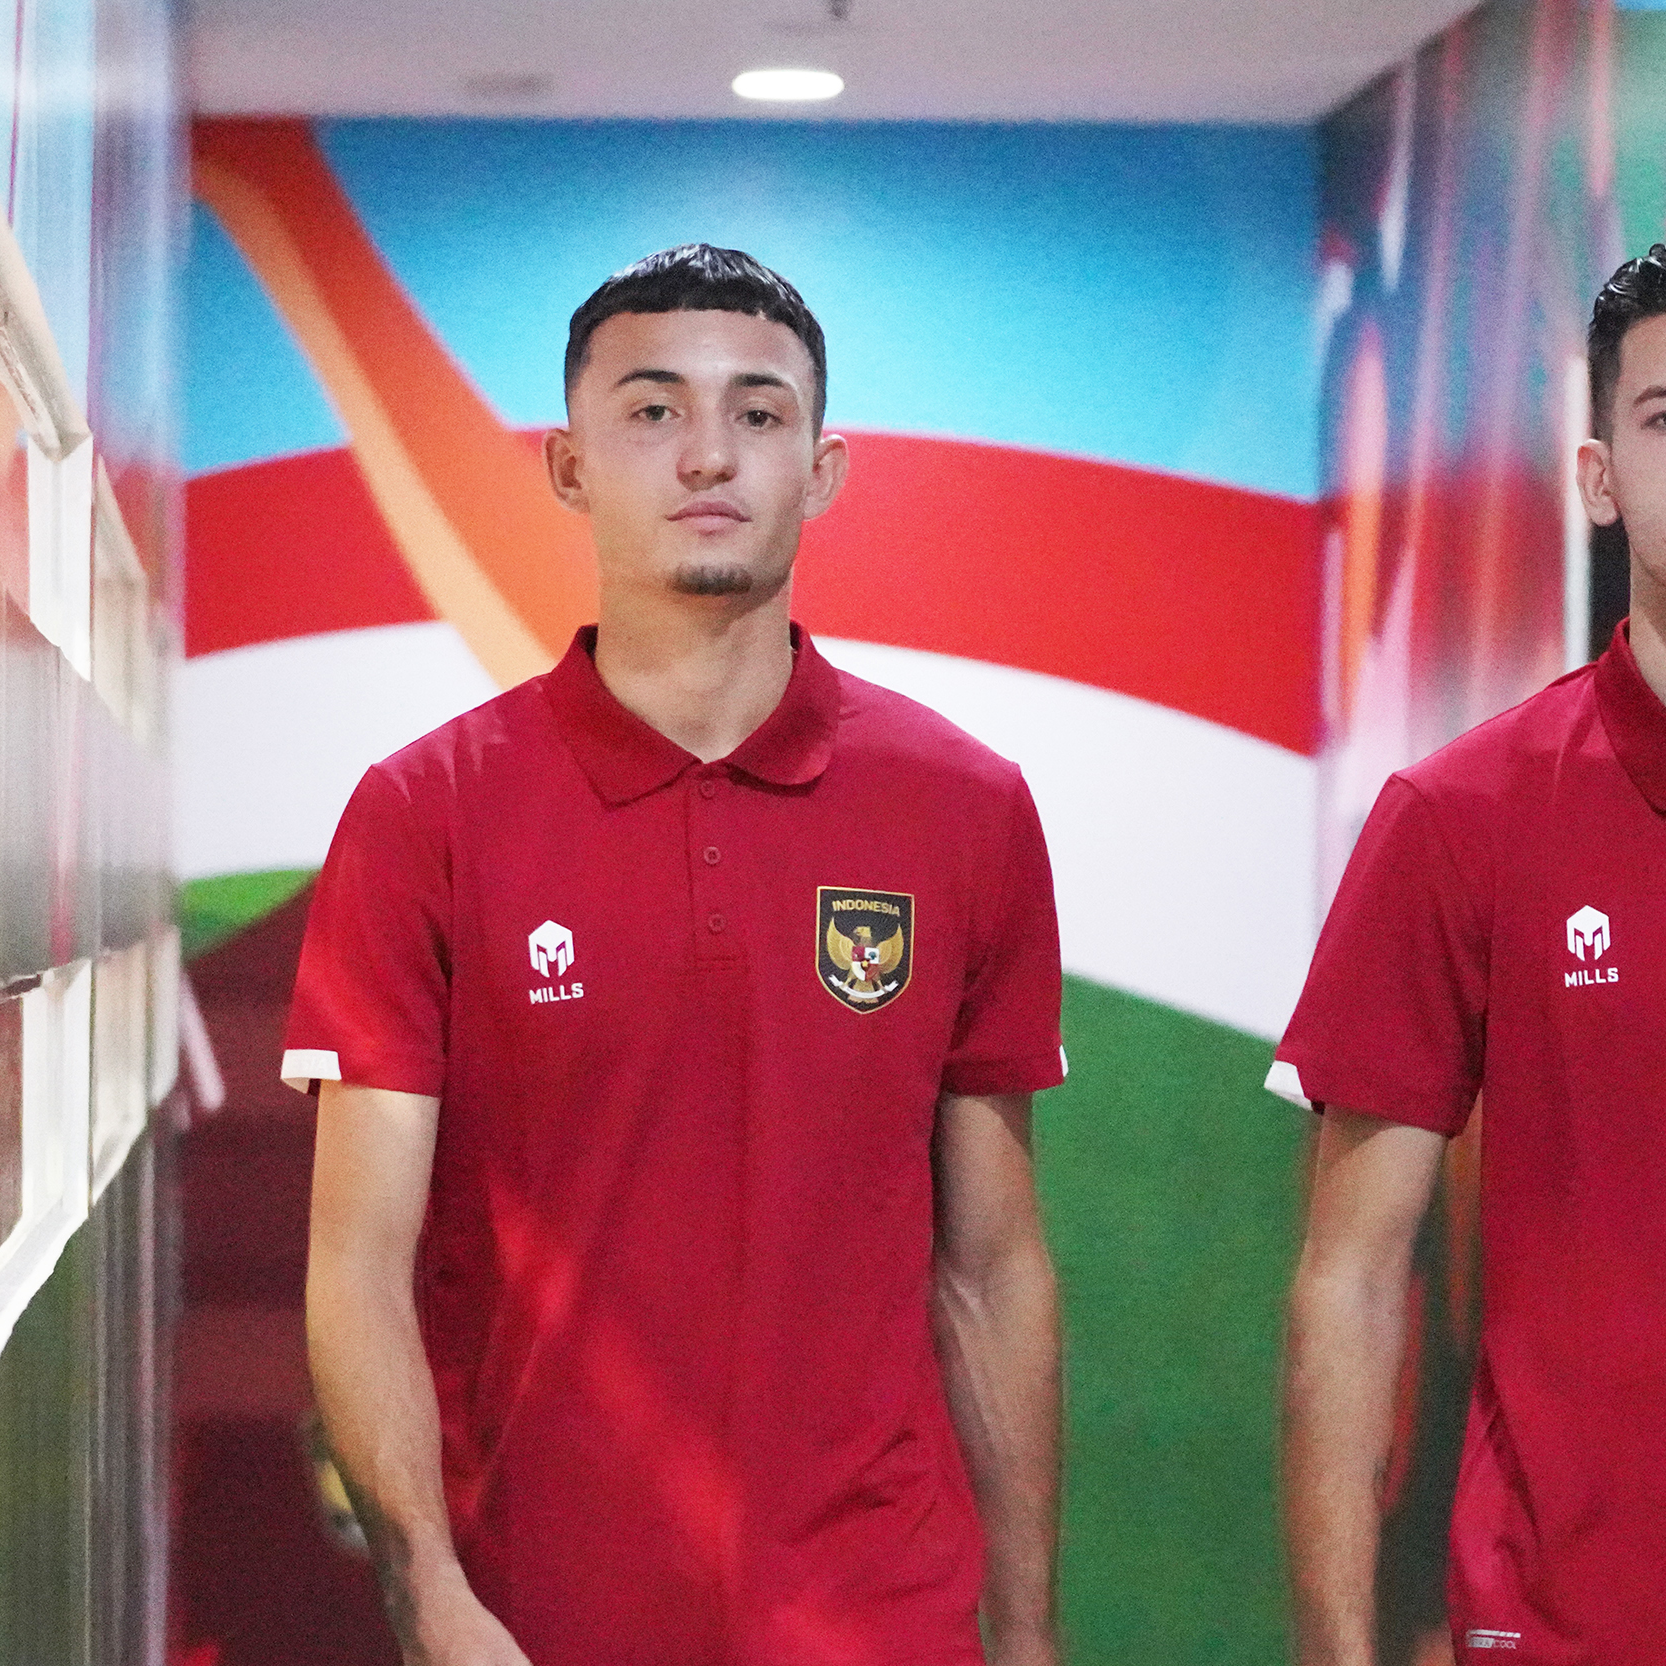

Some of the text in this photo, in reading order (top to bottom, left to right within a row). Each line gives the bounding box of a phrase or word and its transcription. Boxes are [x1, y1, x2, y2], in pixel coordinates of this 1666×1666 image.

[832, 899, 900, 917] INDONESIA
[1564, 967, 1619, 988] MILLS
[529, 982, 584, 1005] MILLS
